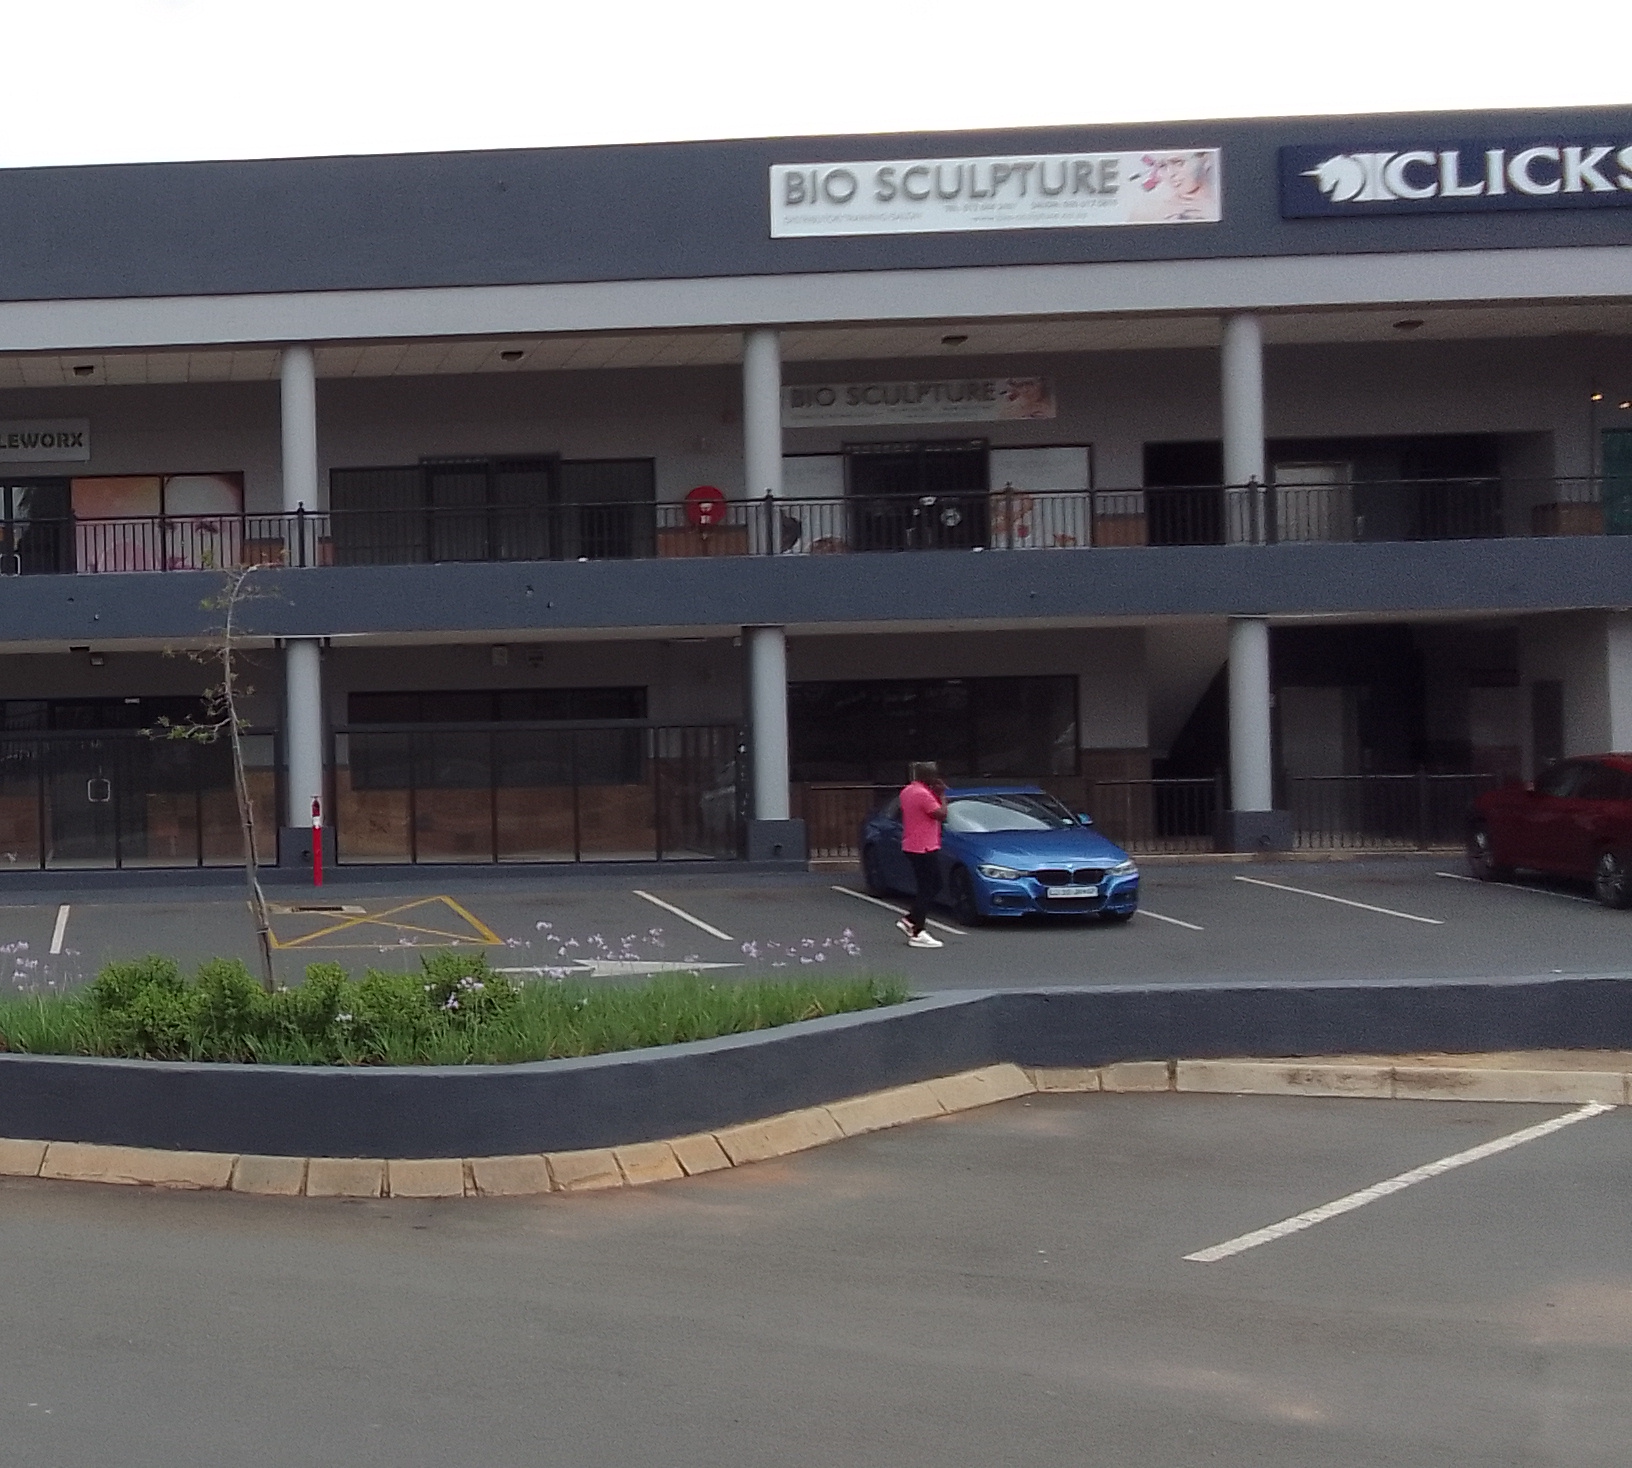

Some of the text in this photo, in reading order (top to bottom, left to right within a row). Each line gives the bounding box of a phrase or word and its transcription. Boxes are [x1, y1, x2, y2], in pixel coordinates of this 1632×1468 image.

[784, 157, 1120, 205] BIO SCULPTURE
[790, 387, 835, 408] BIO
